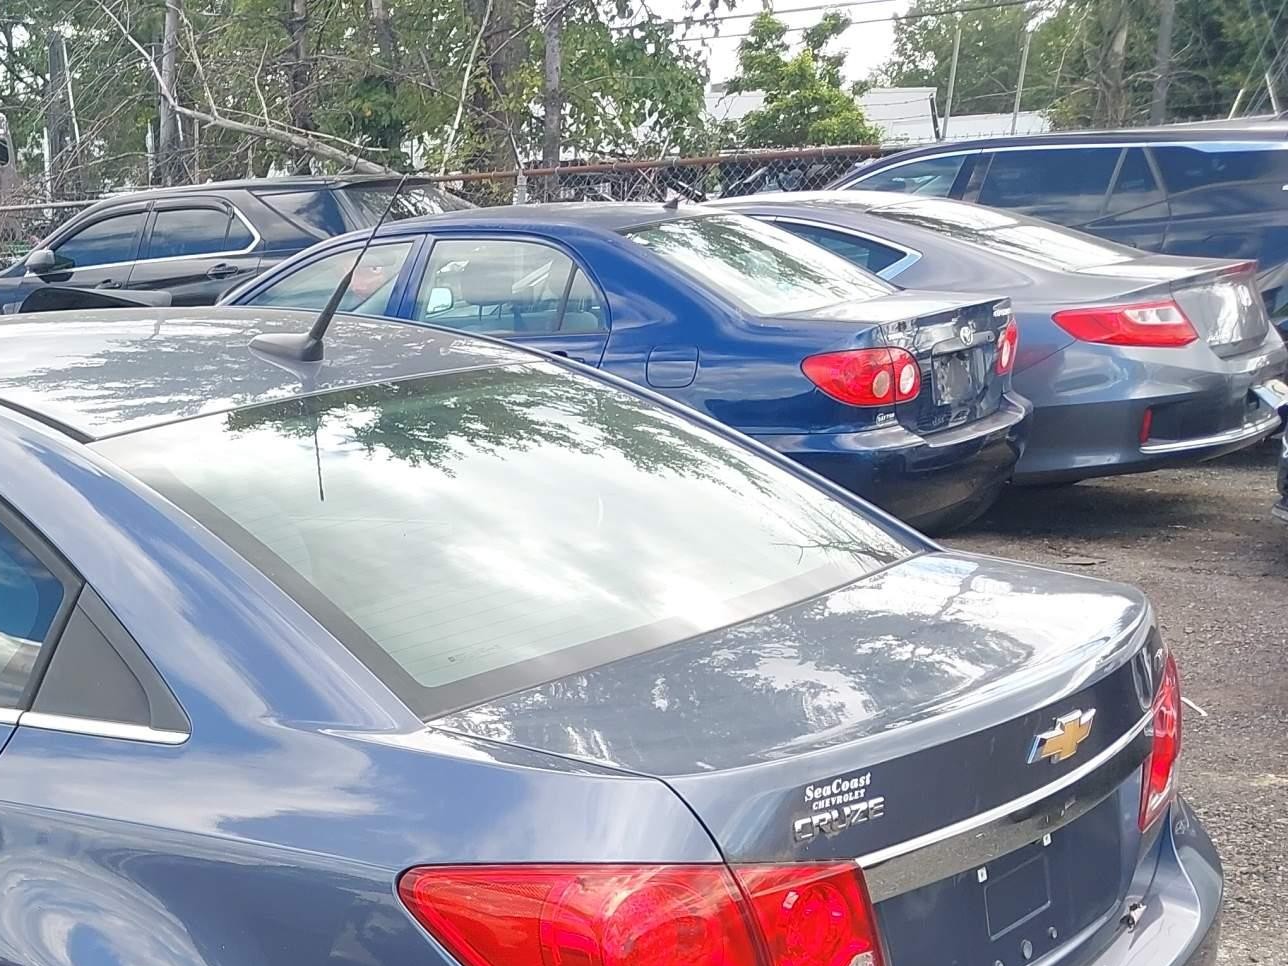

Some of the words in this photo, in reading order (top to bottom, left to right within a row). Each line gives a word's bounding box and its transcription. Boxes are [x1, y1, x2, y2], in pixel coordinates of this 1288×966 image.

[804, 772, 872, 802] SeaCoast
[812, 788, 866, 810] CHEVROLET
[793, 796, 885, 842] CRUZE
